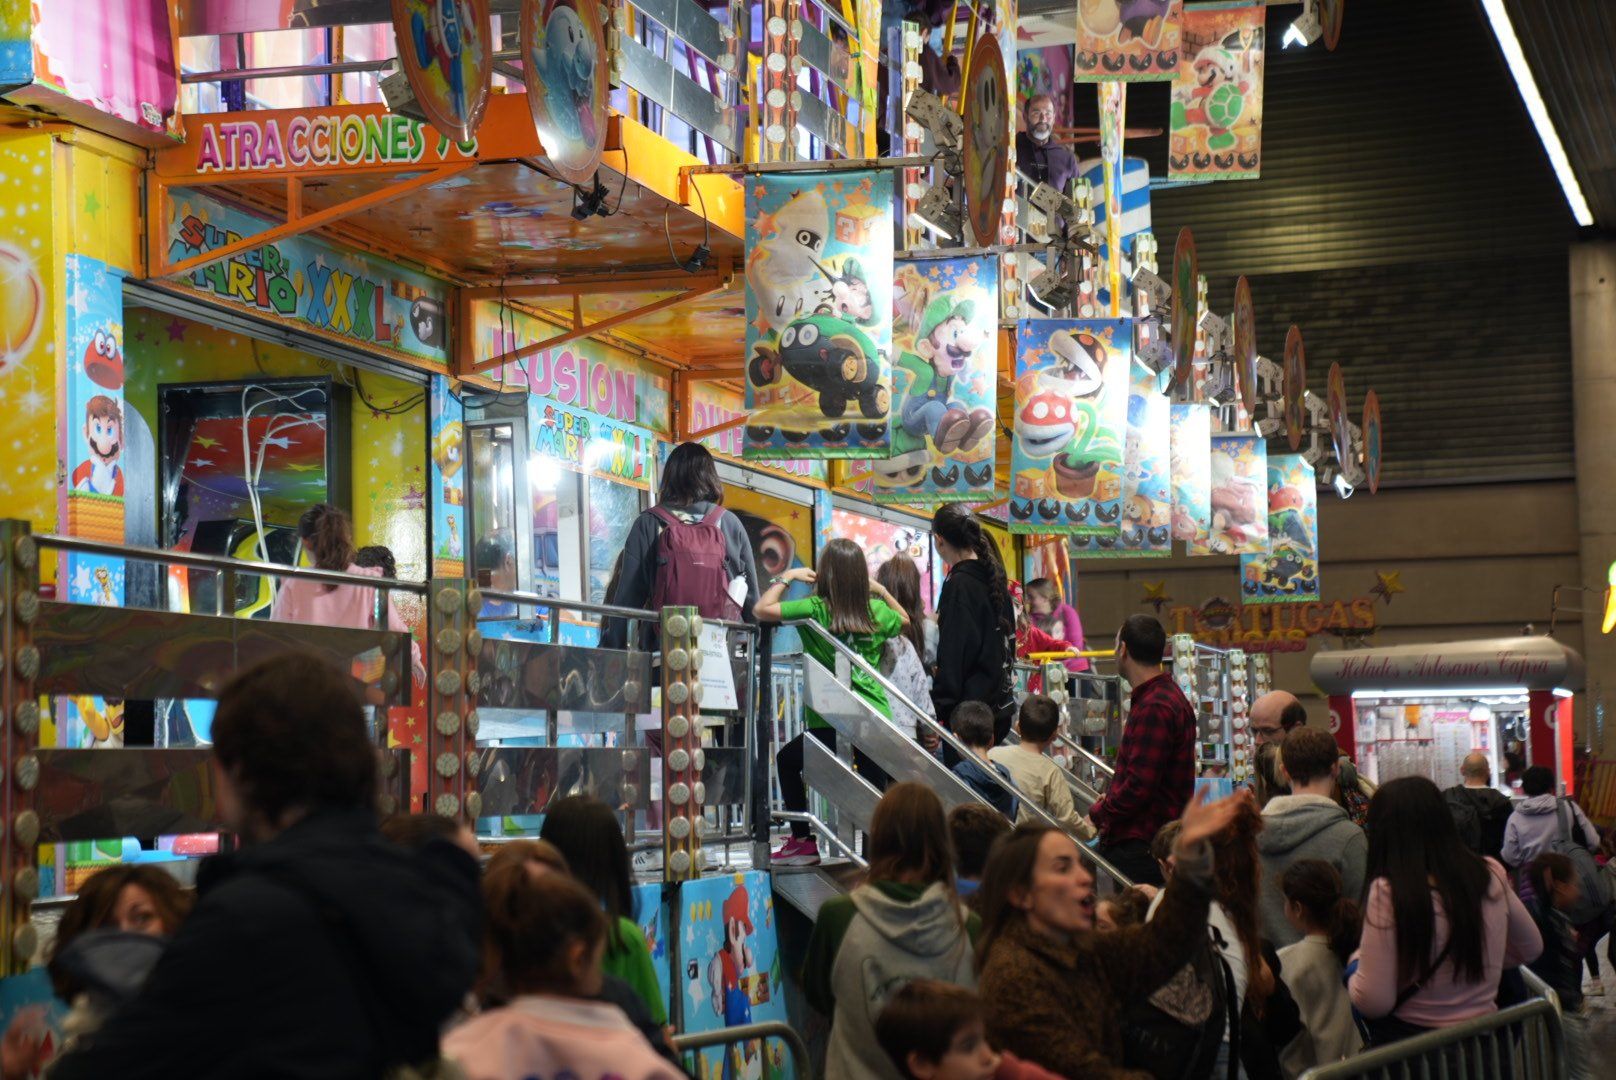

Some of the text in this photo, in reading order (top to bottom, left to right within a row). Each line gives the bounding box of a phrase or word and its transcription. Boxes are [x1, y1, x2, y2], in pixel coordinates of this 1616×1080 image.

[196, 114, 424, 173] ATRACCIONES
[306, 260, 392, 342] XXXL
[491, 327, 637, 423] ILUSION
